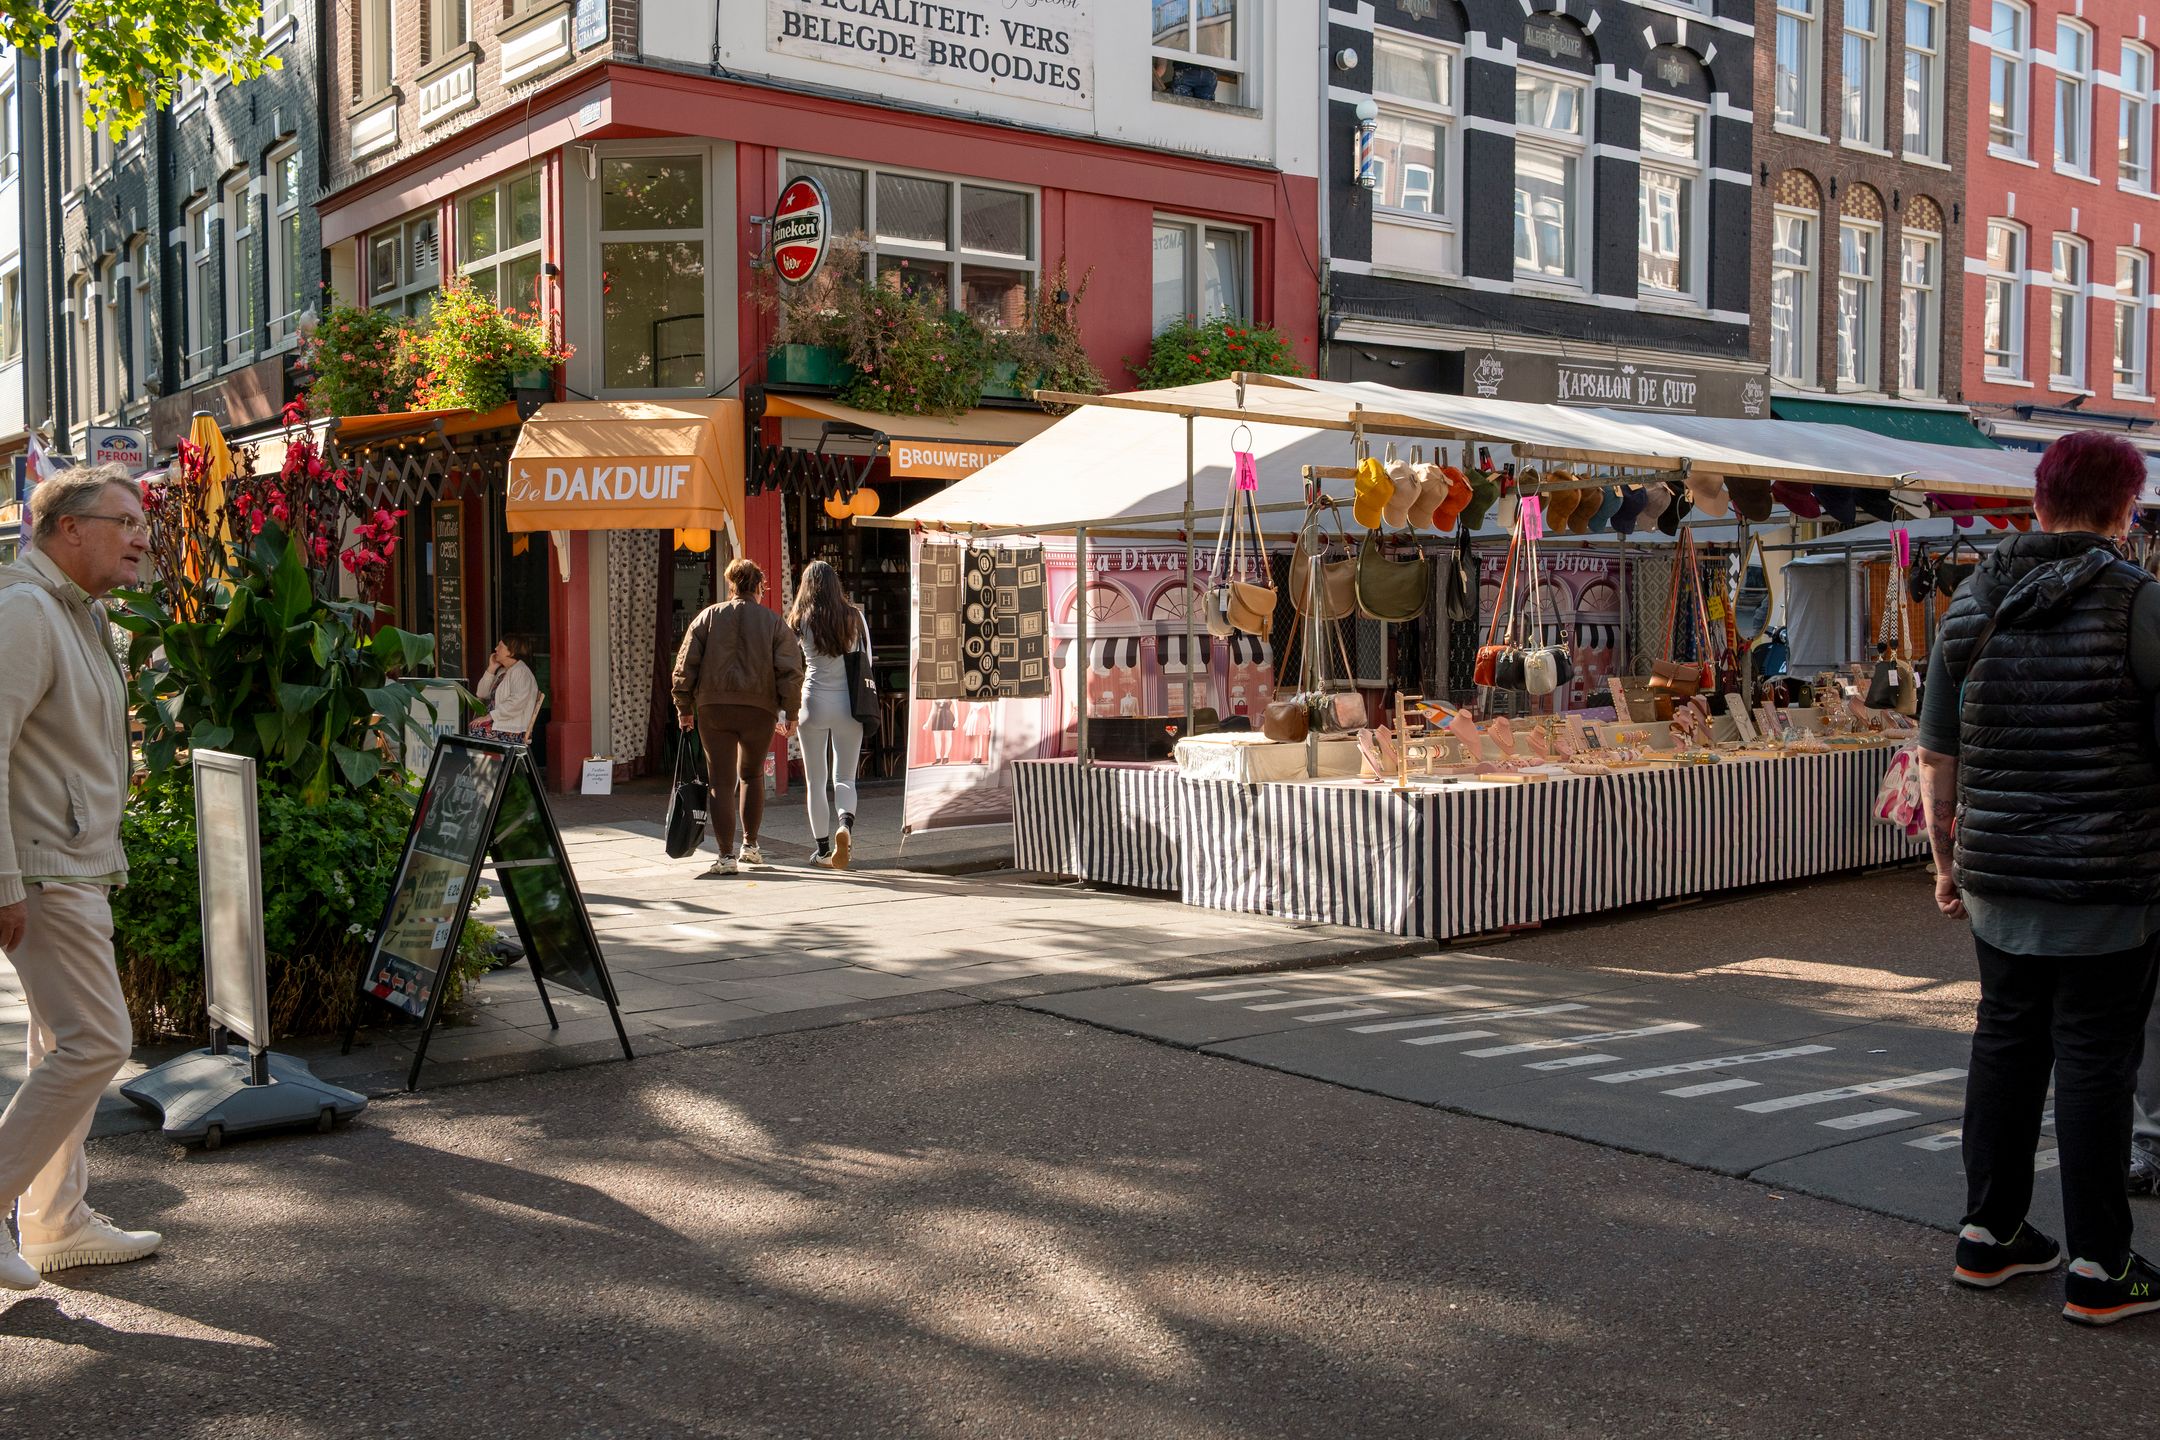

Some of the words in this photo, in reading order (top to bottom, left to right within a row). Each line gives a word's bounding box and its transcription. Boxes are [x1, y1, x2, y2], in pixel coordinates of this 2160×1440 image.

[1000, 19, 1069, 55] VERS
[782, 10, 917, 60] BELEGDE
[928, 39, 1081, 91] BROODJES
[774, 220, 816, 242] eineken
[783, 253, 802, 271] bier
[1557, 369, 1632, 400] KAPSALON
[1638, 376, 1657, 405] DE
[1663, 378, 1697, 407] CUYP
[97, 449, 142, 462] PERONI
[510, 478, 541, 502] De
[544, 465, 690, 502] DAKDUIF
[1119, 547, 1179, 572] Diva
[1554, 552, 1609, 575] Bijoux
[447, 883, 461, 897] €26
